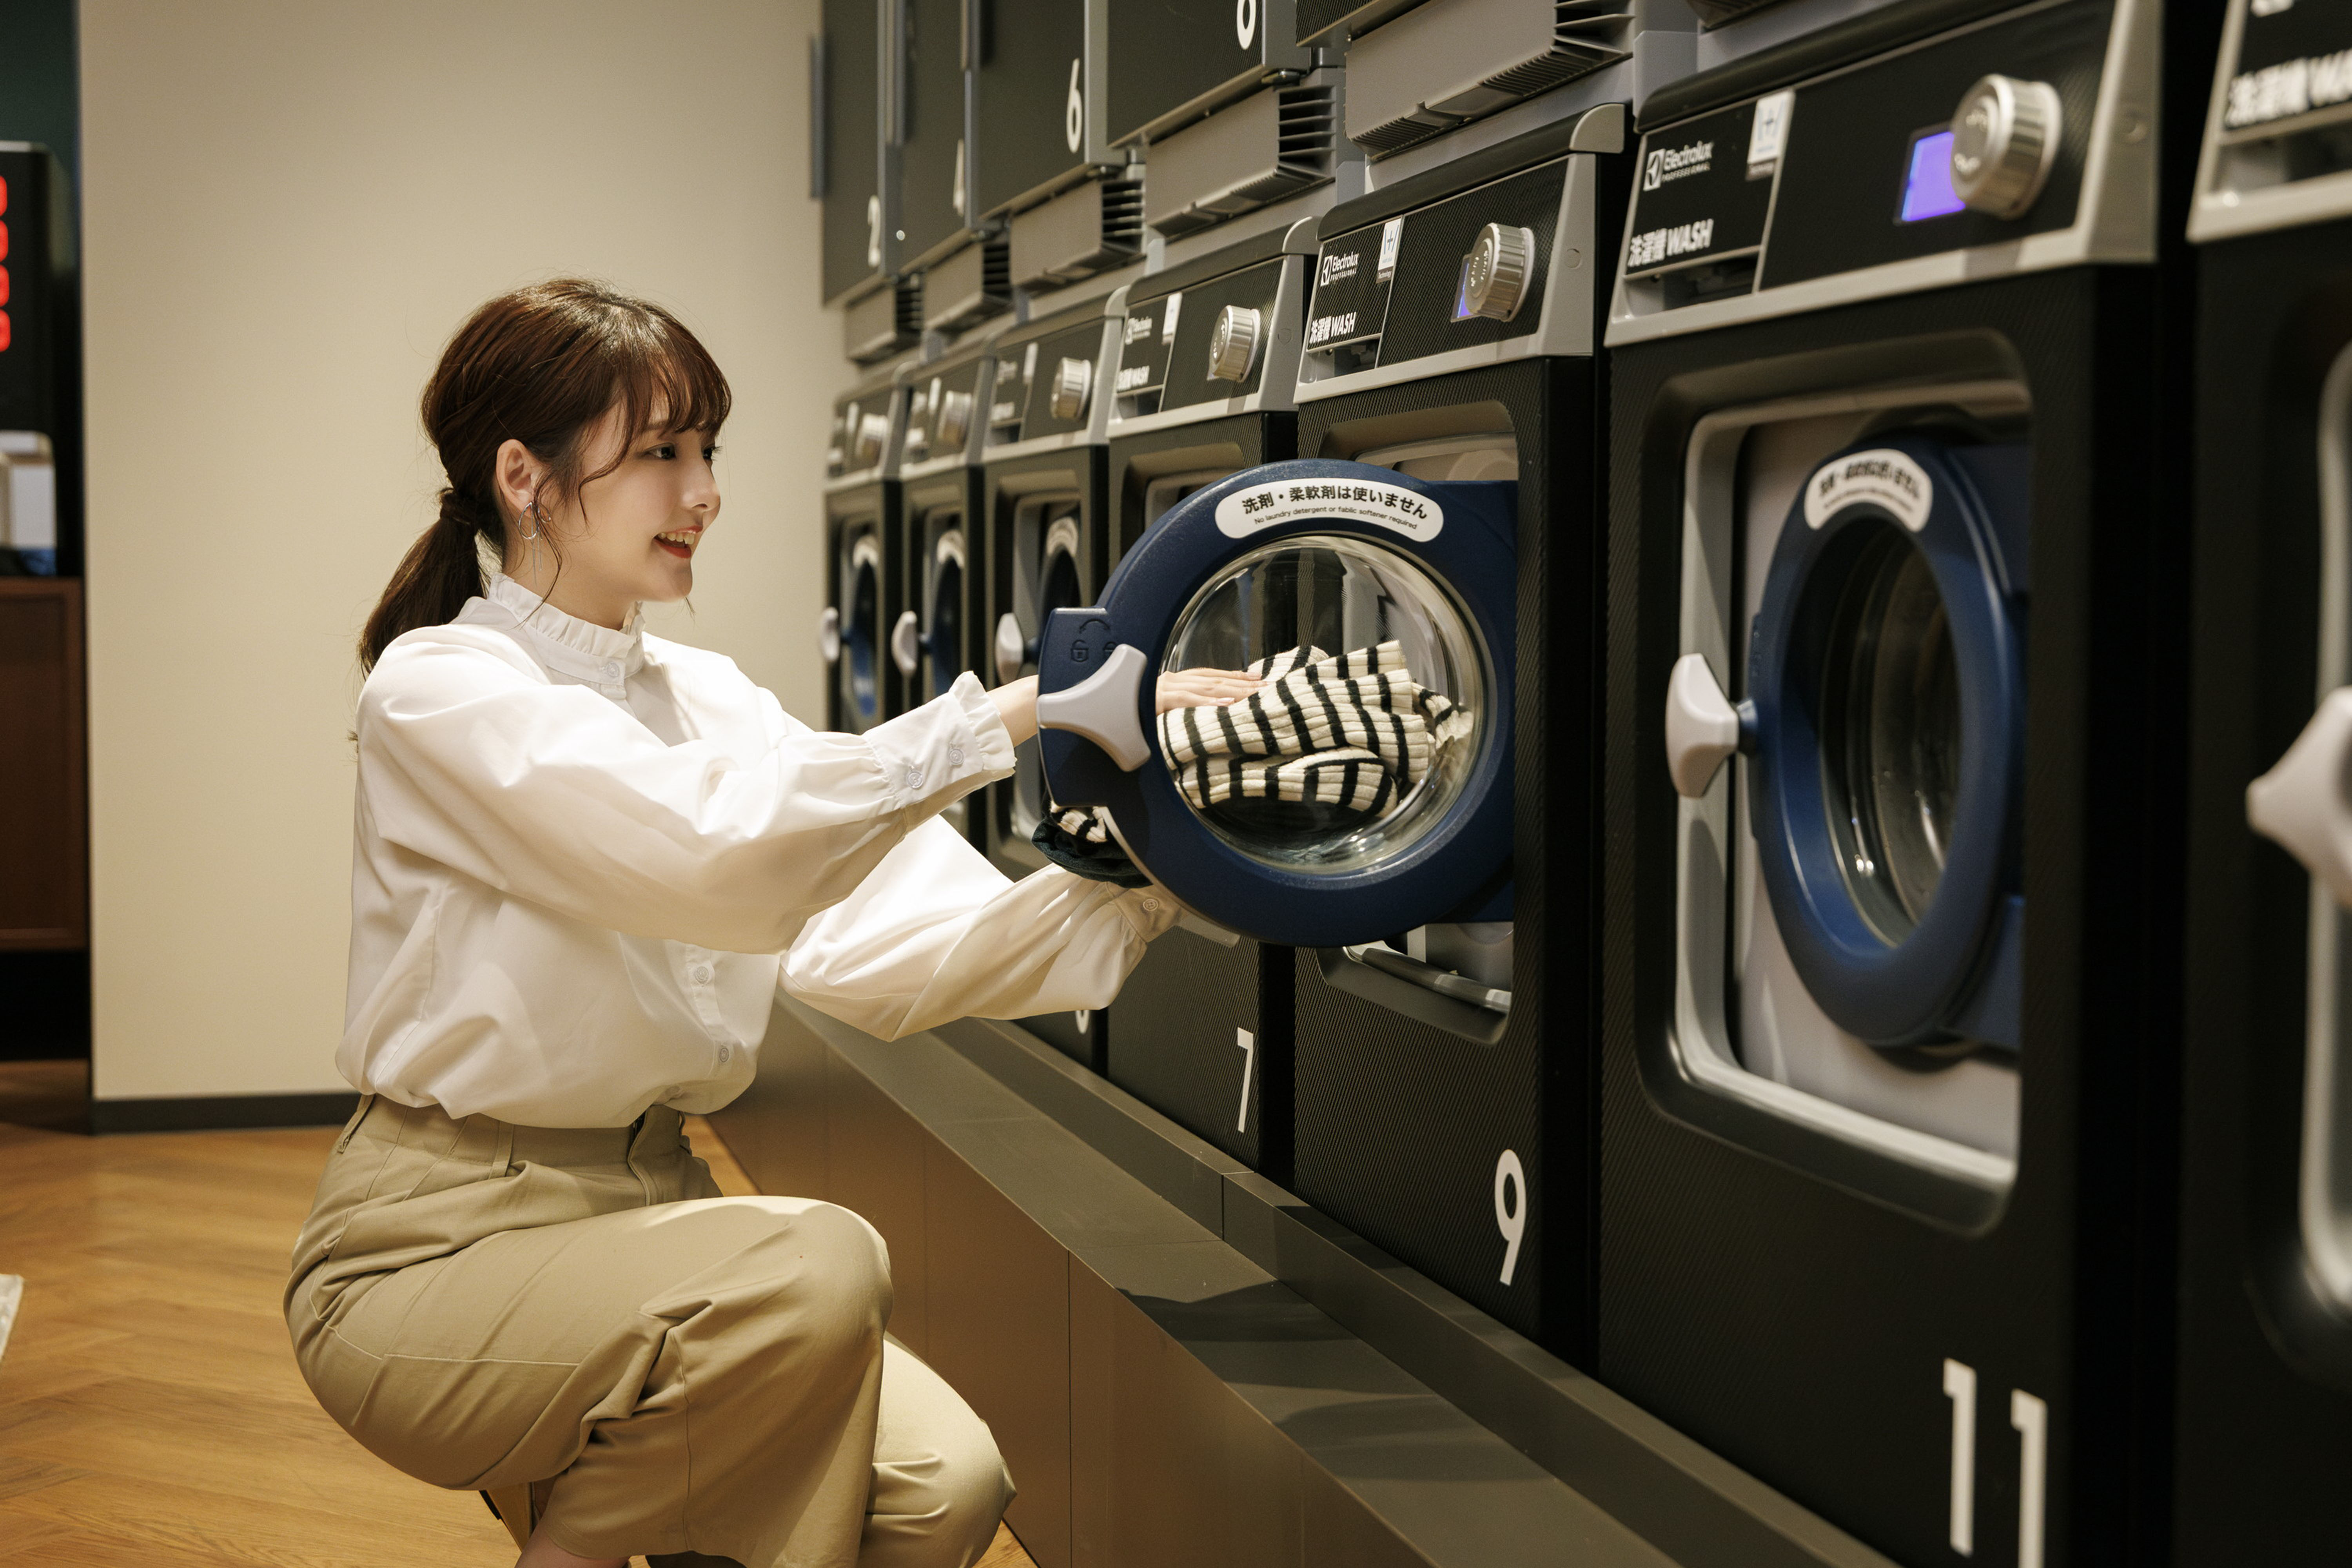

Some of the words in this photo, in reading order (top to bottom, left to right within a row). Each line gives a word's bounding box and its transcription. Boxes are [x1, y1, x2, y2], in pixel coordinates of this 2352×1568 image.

[1066, 58, 1083, 153] 6
[1664, 140, 1715, 171] Electrolux
[1667, 218, 1714, 256] WASH
[1332, 251, 1359, 272] Electrolux
[1331, 312, 1356, 337] WASH
[1242, 485, 1427, 519] 洗剤・柔軟剤は使いません
[1265, 510, 1291, 520] laundry
[1359, 509, 1388, 519] softener
[1389, 516, 1418, 529] required
[1238, 1027, 1254, 1133] 7
[1494, 1149, 1527, 1286] 9
[1943, 1356, 2048, 1568] 11
